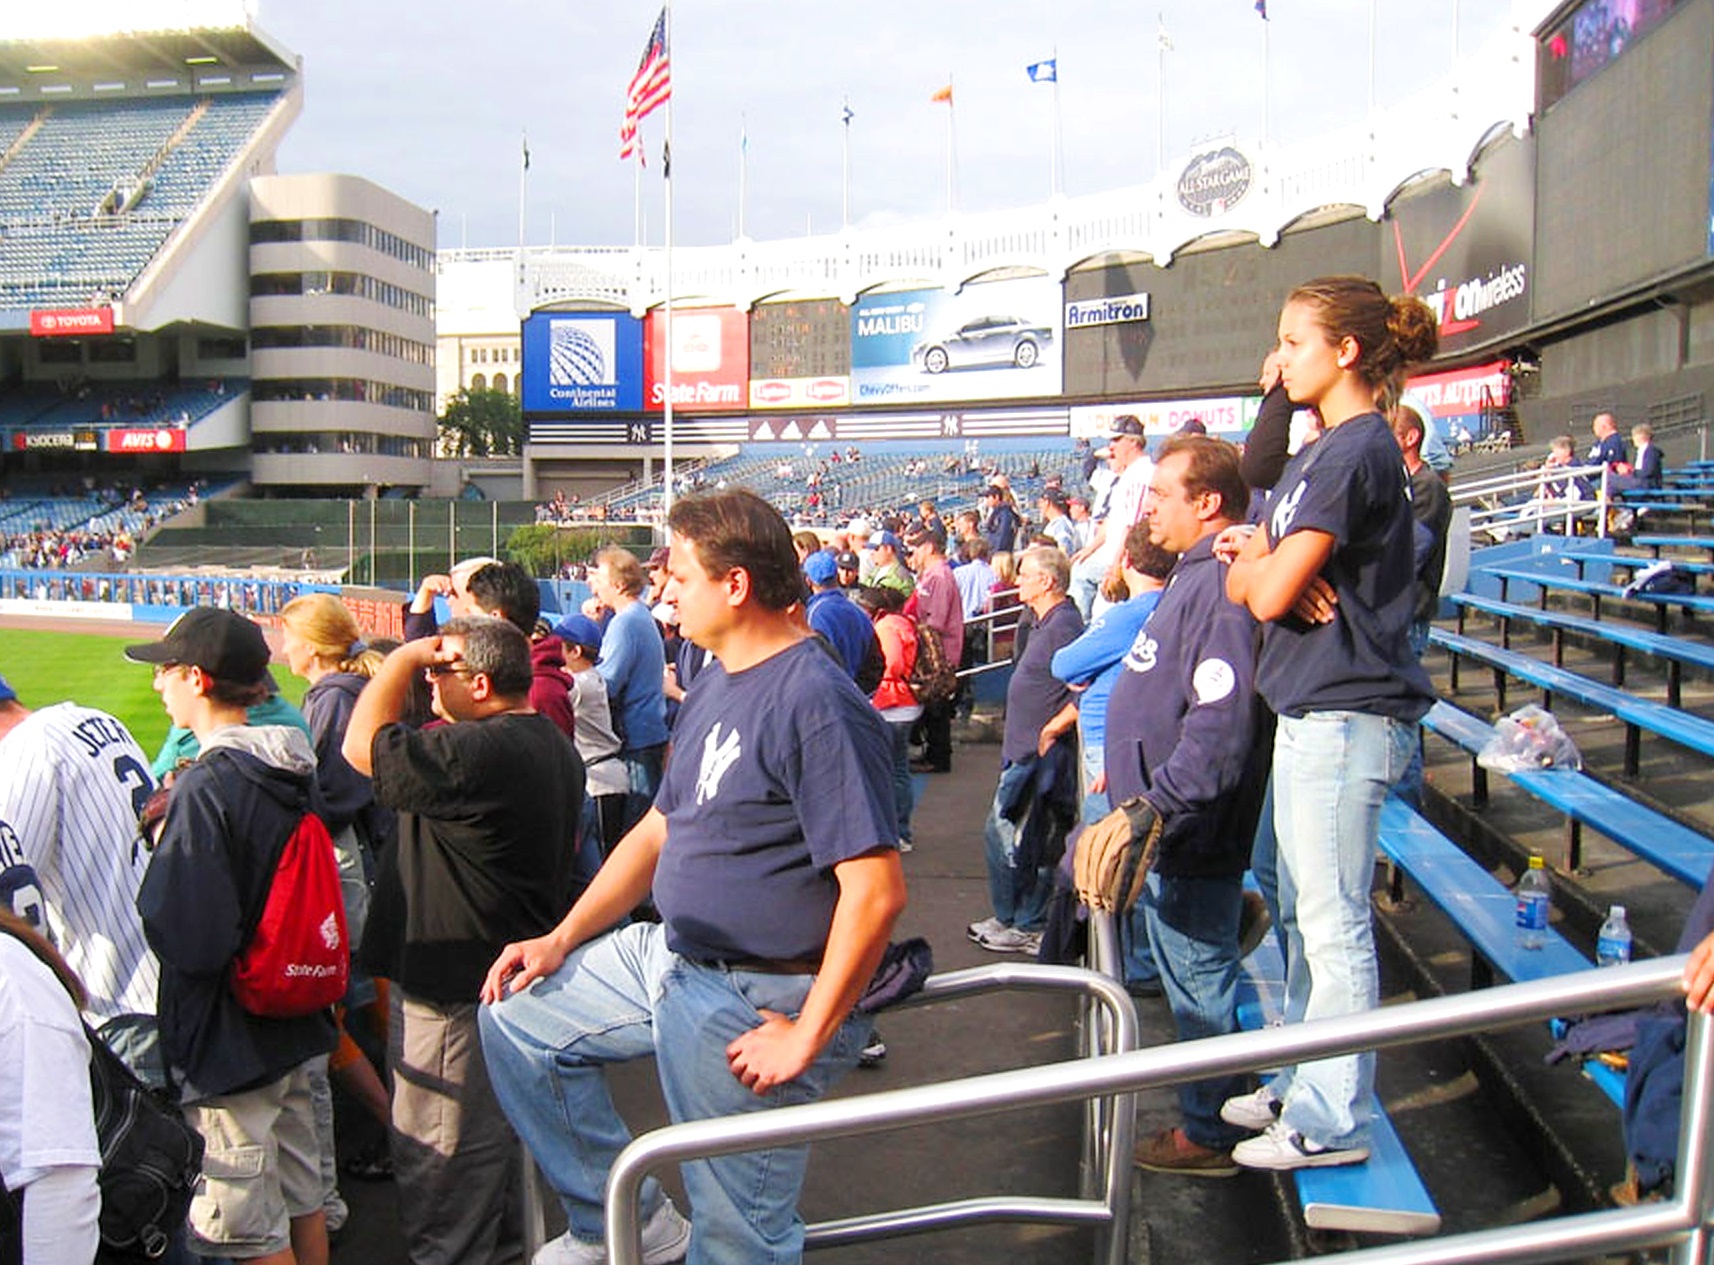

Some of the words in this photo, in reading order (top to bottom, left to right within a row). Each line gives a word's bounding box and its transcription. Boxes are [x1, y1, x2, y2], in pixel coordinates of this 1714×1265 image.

[1069, 302, 1143, 325] Armitron
[1427, 279, 1481, 336] rizon
[57, 315, 101, 326] TOYOTA
[858, 313, 924, 336] MALIBU
[550, 387, 616, 399] Continental
[652, 382, 695, 403] Sate
[696, 382, 740, 403] Farm
[572, 397, 616, 408] Airlines
[26, 433, 74, 447] KYOCERA
[122, 433, 155, 448] AVIS
